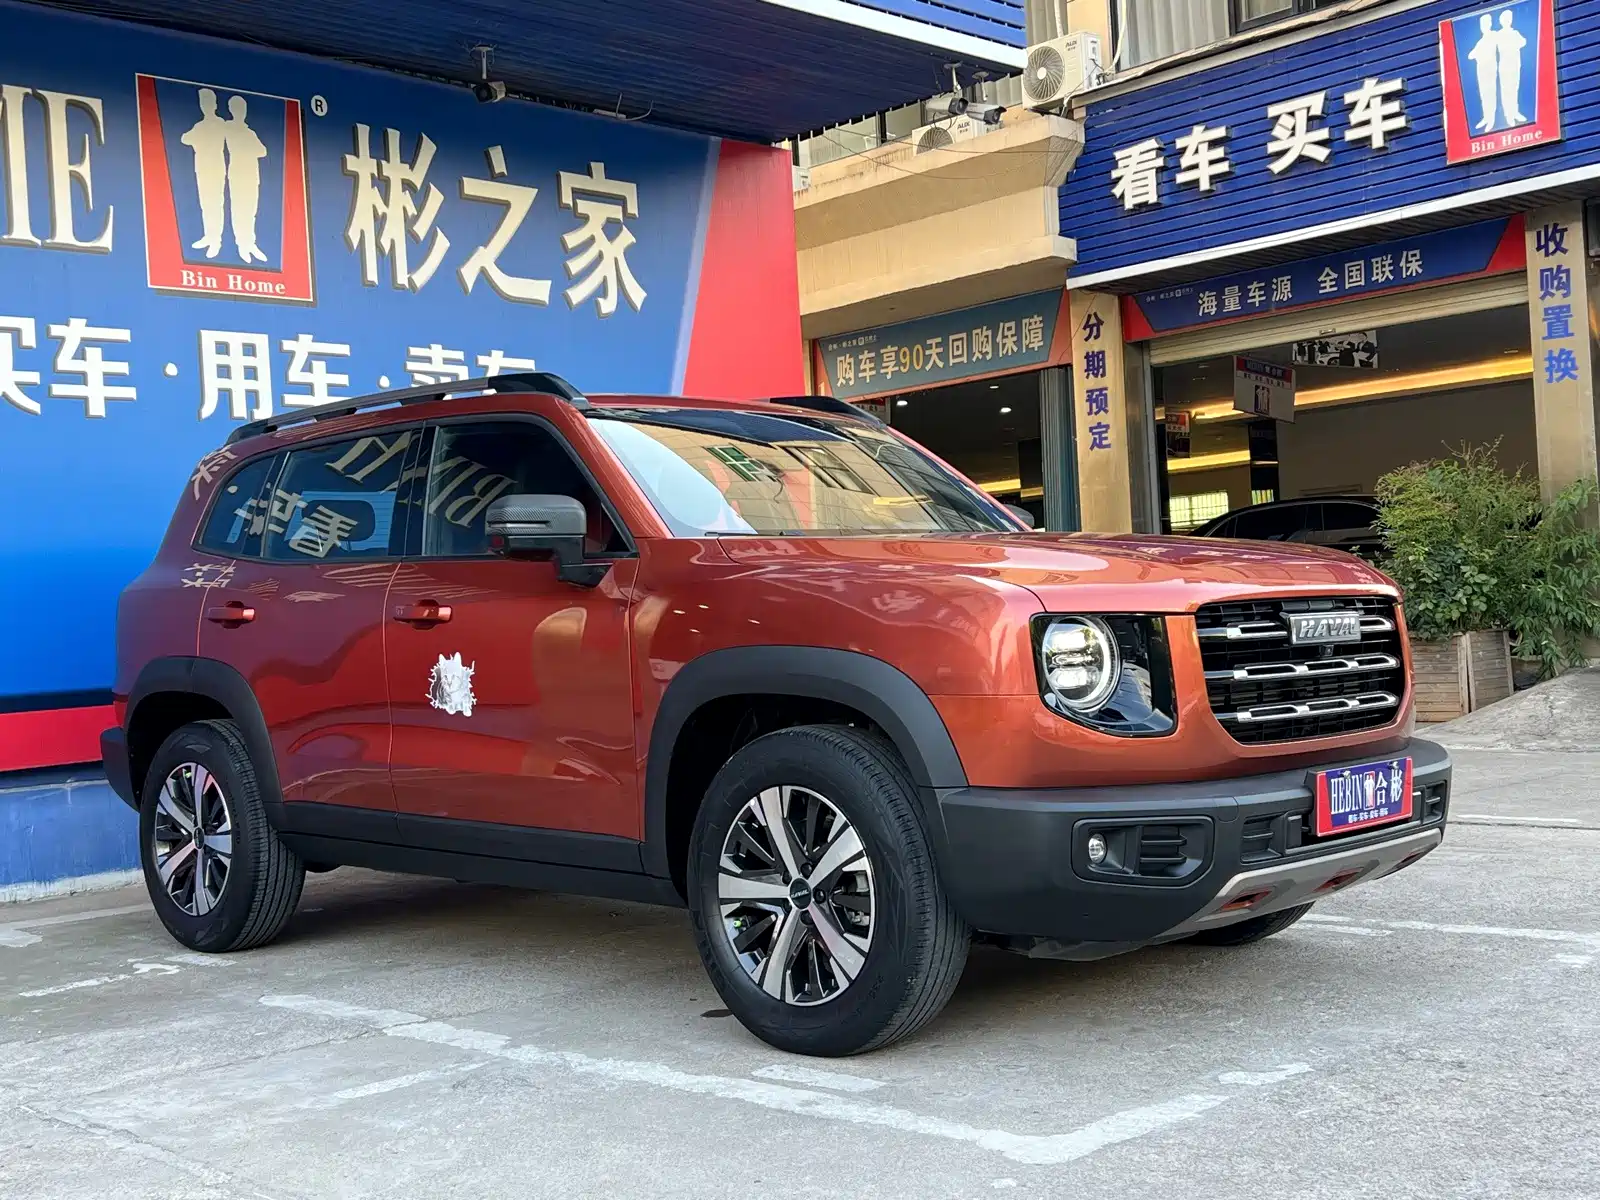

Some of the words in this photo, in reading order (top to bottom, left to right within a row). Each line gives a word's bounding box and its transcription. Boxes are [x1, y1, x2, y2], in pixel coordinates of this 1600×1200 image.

[1111, 125, 1232, 211] 看车
[1266, 77, 1408, 175] 买车
[1471, 140, 1495, 154] Bin
[1501, 129, 1543, 147] Home
[342, 122, 648, 319] 彬之家
[180, 270, 217, 289] Bin
[227, 274, 286, 295] Home
[1317, 249, 1423, 294] 全国联保
[1198, 275, 1292, 317] 海量车源
[1535, 222, 1579, 384] 收购置换
[836, 314, 1044, 388] 购车享90天回购保障
[1082, 311, 1111, 451] 分期预定
[1299, 618, 1356, 638] HAVAL
[1330, 774, 1363, 815] HEBIN
[1375, 768, 1403, 806] 合彬
